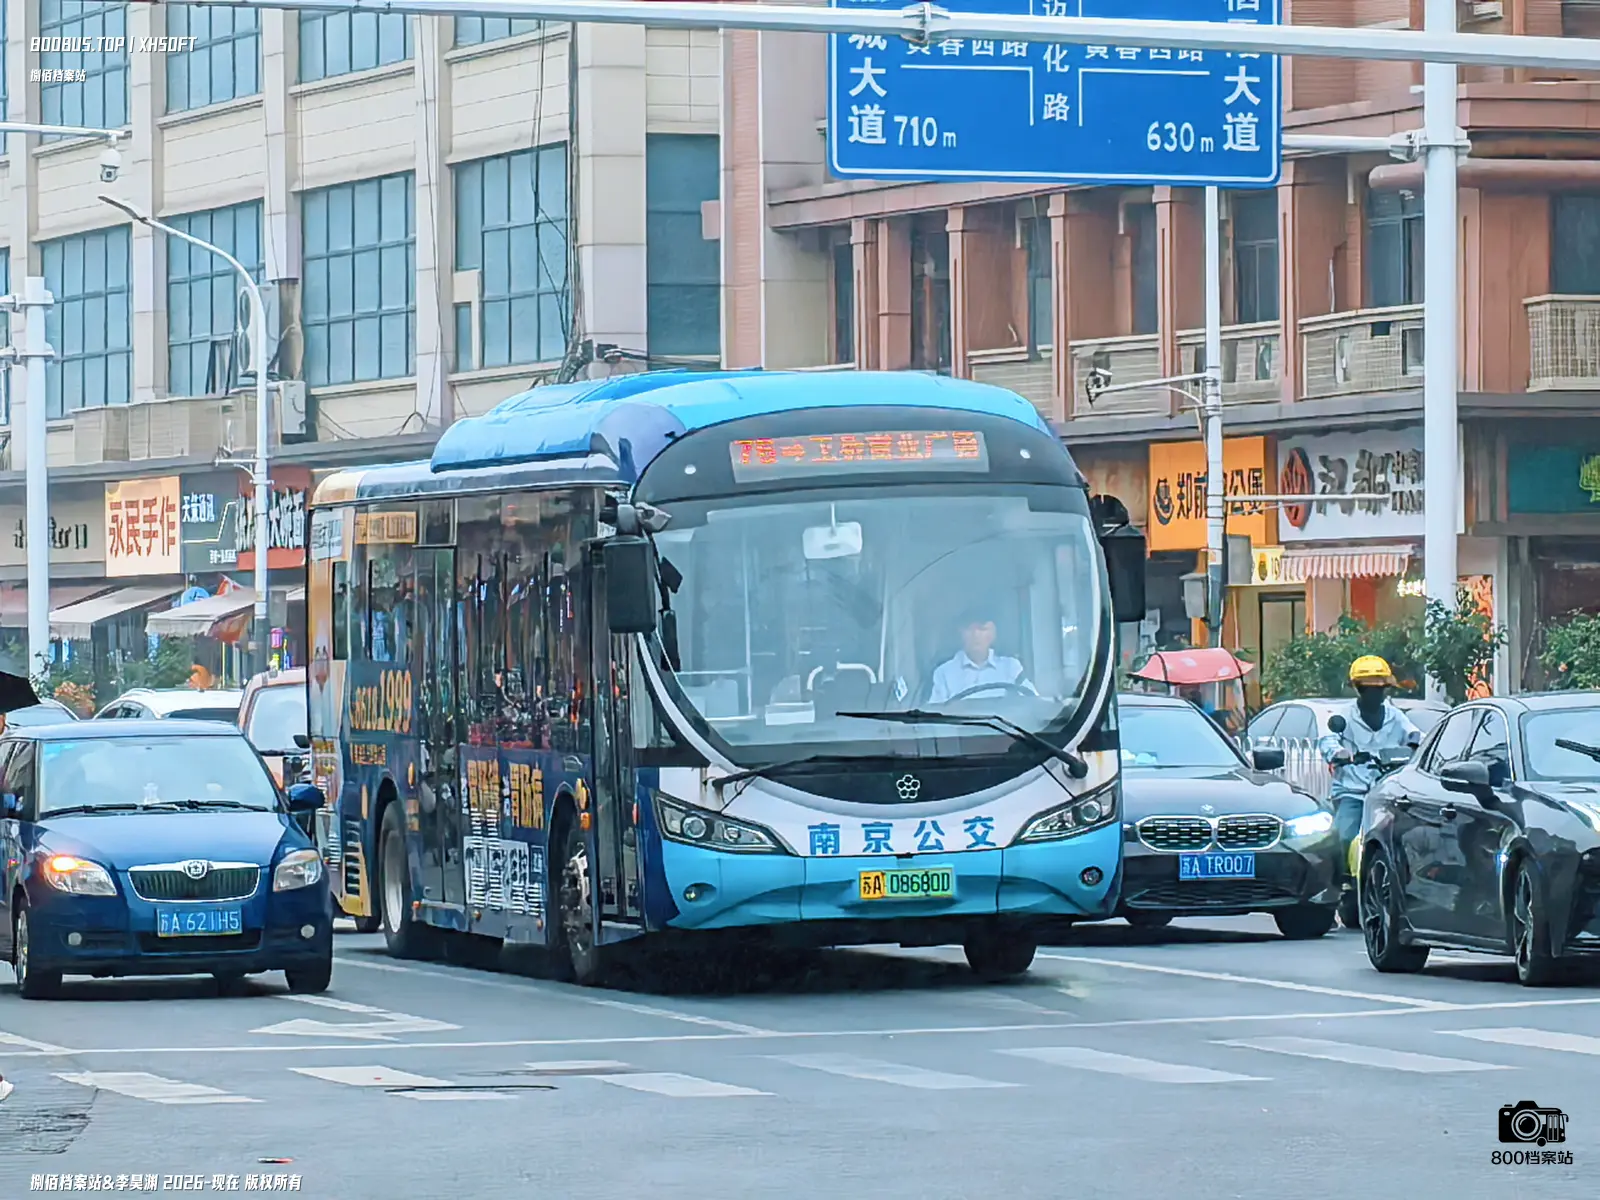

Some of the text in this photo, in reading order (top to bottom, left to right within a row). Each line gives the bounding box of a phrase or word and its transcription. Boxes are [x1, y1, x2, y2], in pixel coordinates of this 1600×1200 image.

[1176, 467, 1263, 519] 郑前公煲
[807, 816, 997, 856] 南京公交
